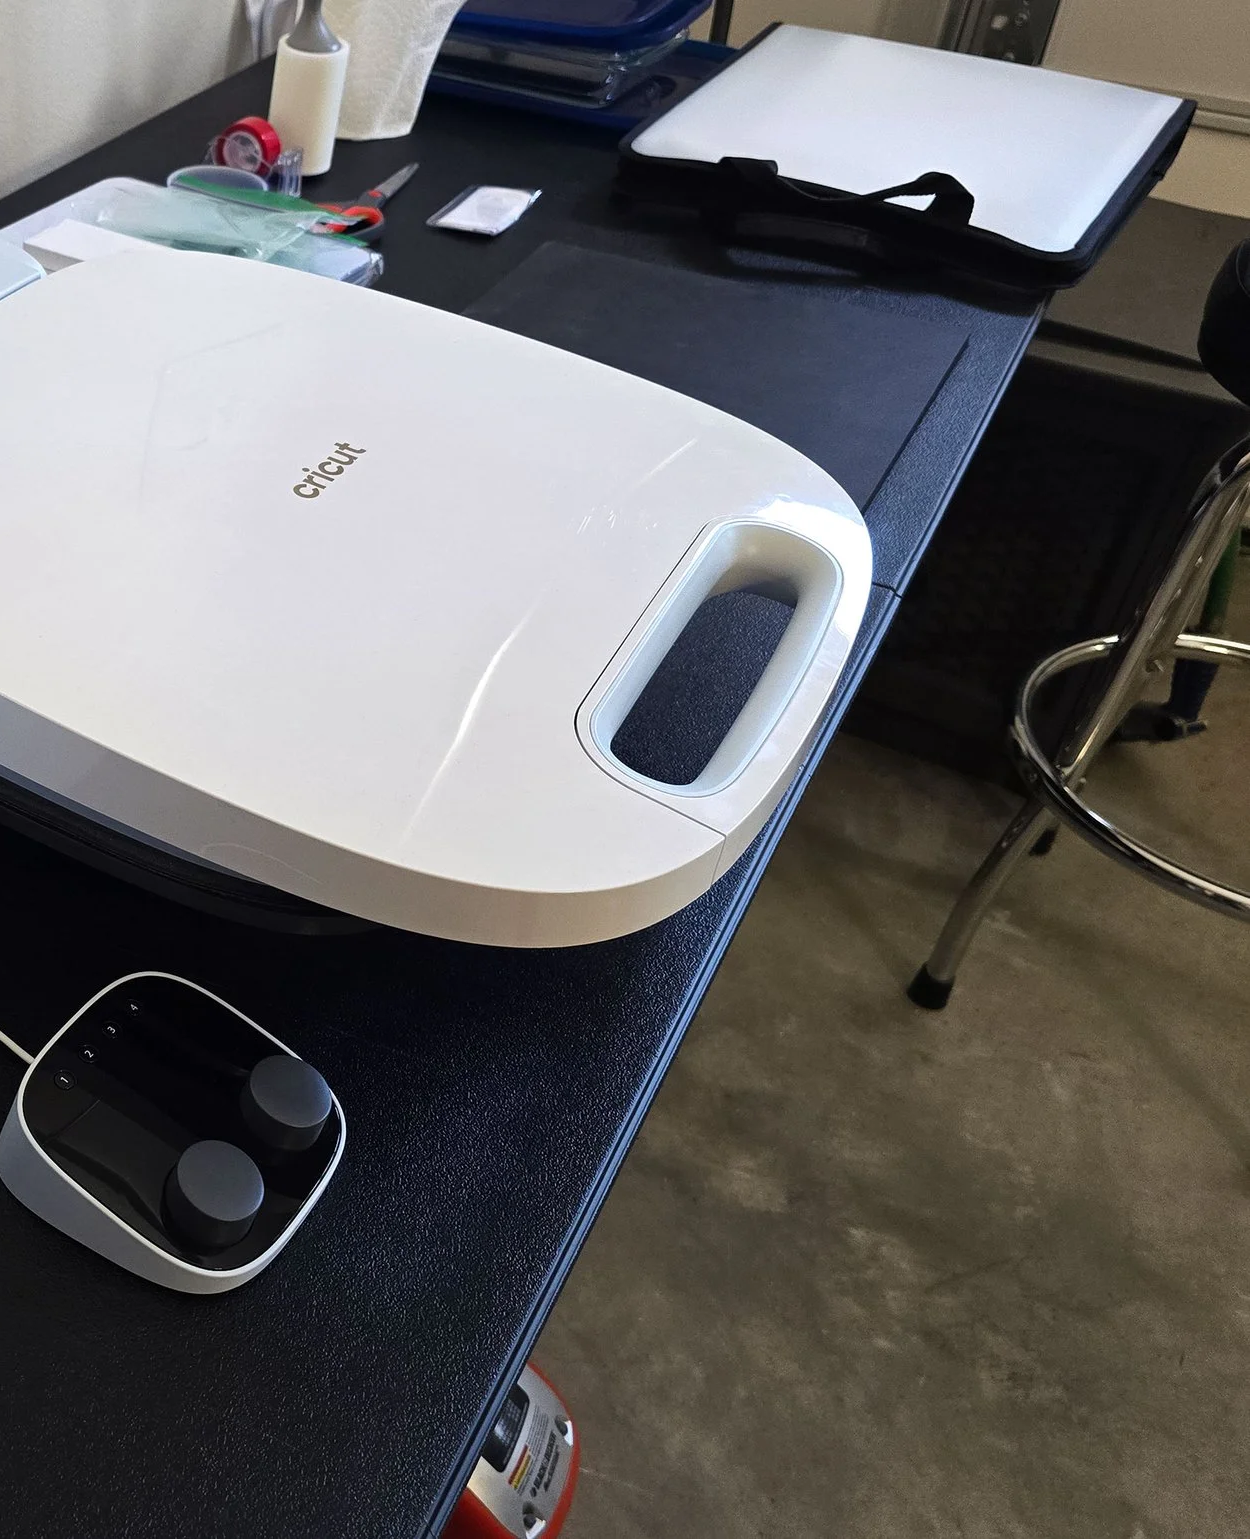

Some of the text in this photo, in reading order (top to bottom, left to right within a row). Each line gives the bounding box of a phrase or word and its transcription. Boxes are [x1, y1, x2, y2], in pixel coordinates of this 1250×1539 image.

[292, 442, 367, 499] cricut
[60, 1003, 138, 1084] 1 2 3 4
